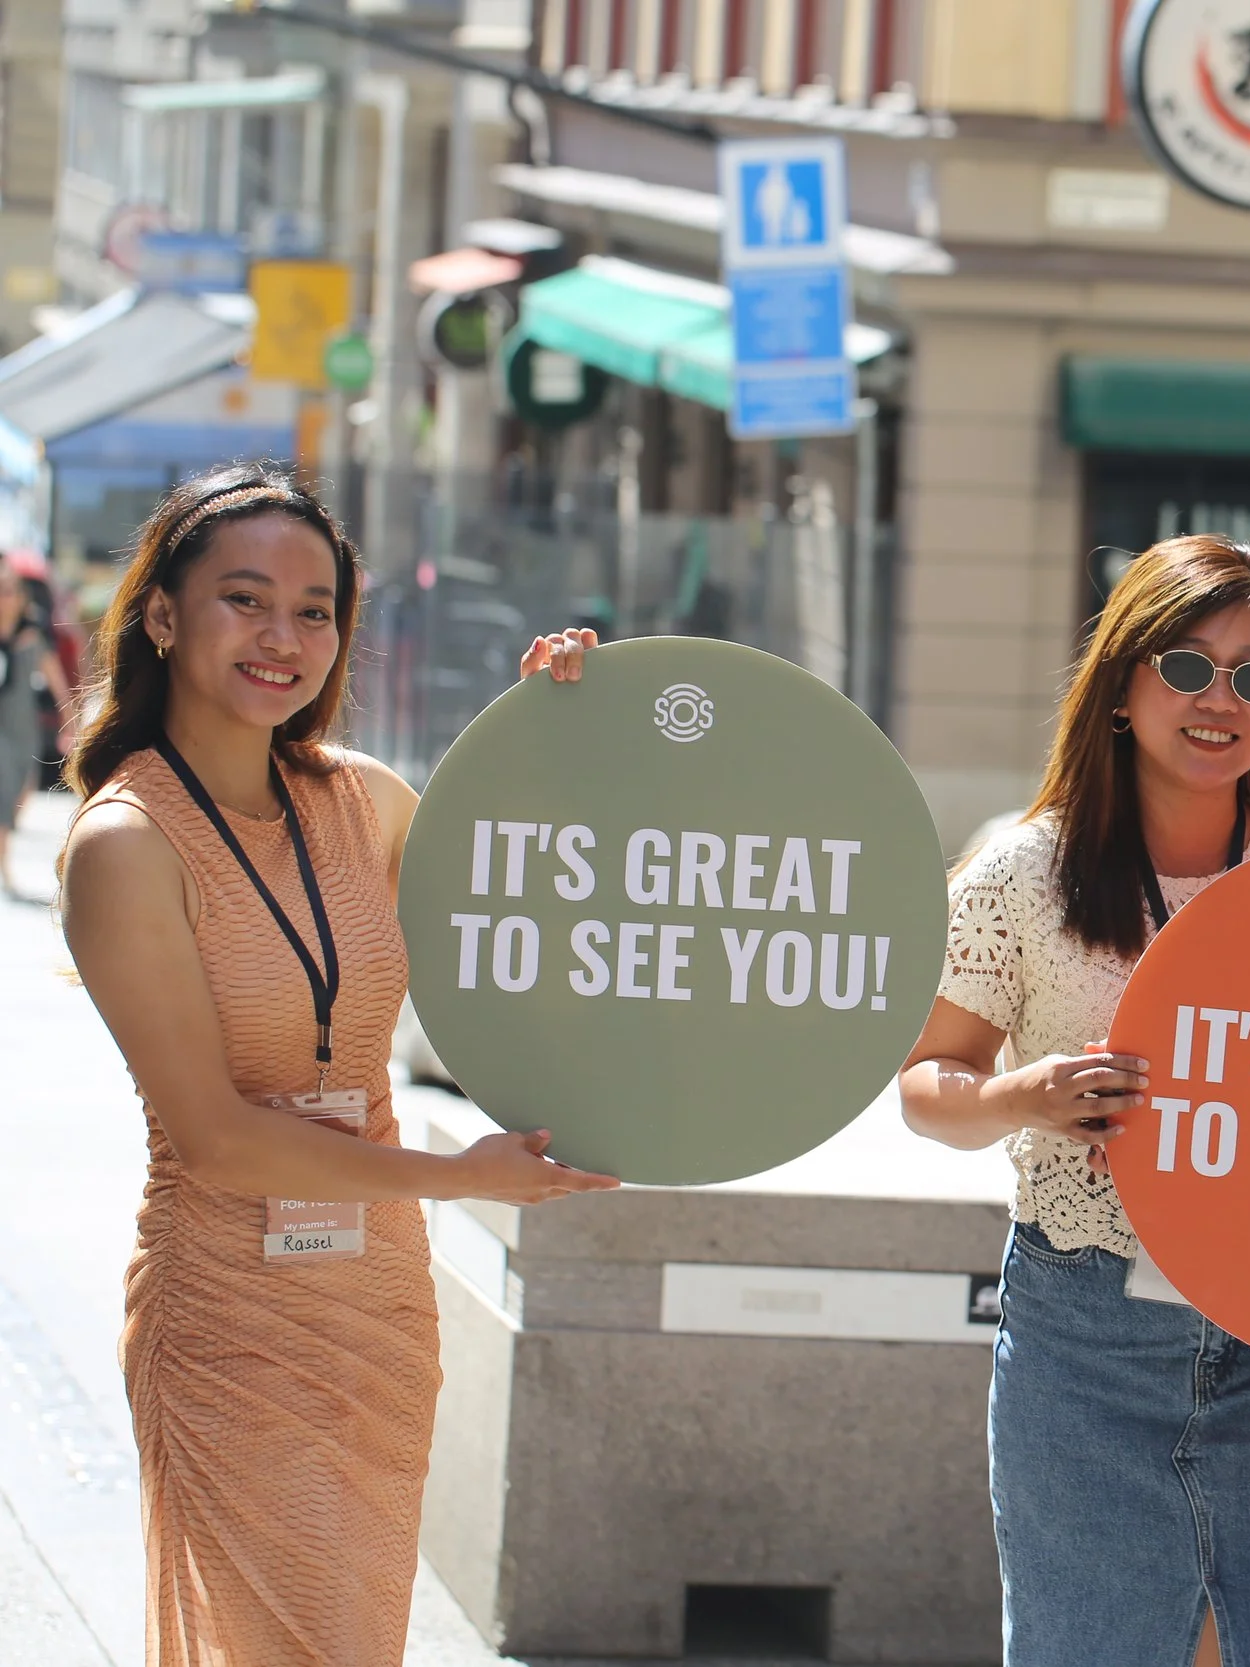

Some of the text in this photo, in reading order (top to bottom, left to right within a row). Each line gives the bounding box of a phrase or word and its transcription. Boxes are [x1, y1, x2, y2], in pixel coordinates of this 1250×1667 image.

[654, 697, 714, 729] SOS
[470, 820, 861, 914] IT'S GREAT
[451, 913, 890, 1011] TO SEE YOU!
[1151, 1097, 1238, 1177] TO
[281, 1200, 305, 1210] FOR
[284, 1219, 337, 1232] My name is:
[284, 1235, 332, 1251] Rassel
